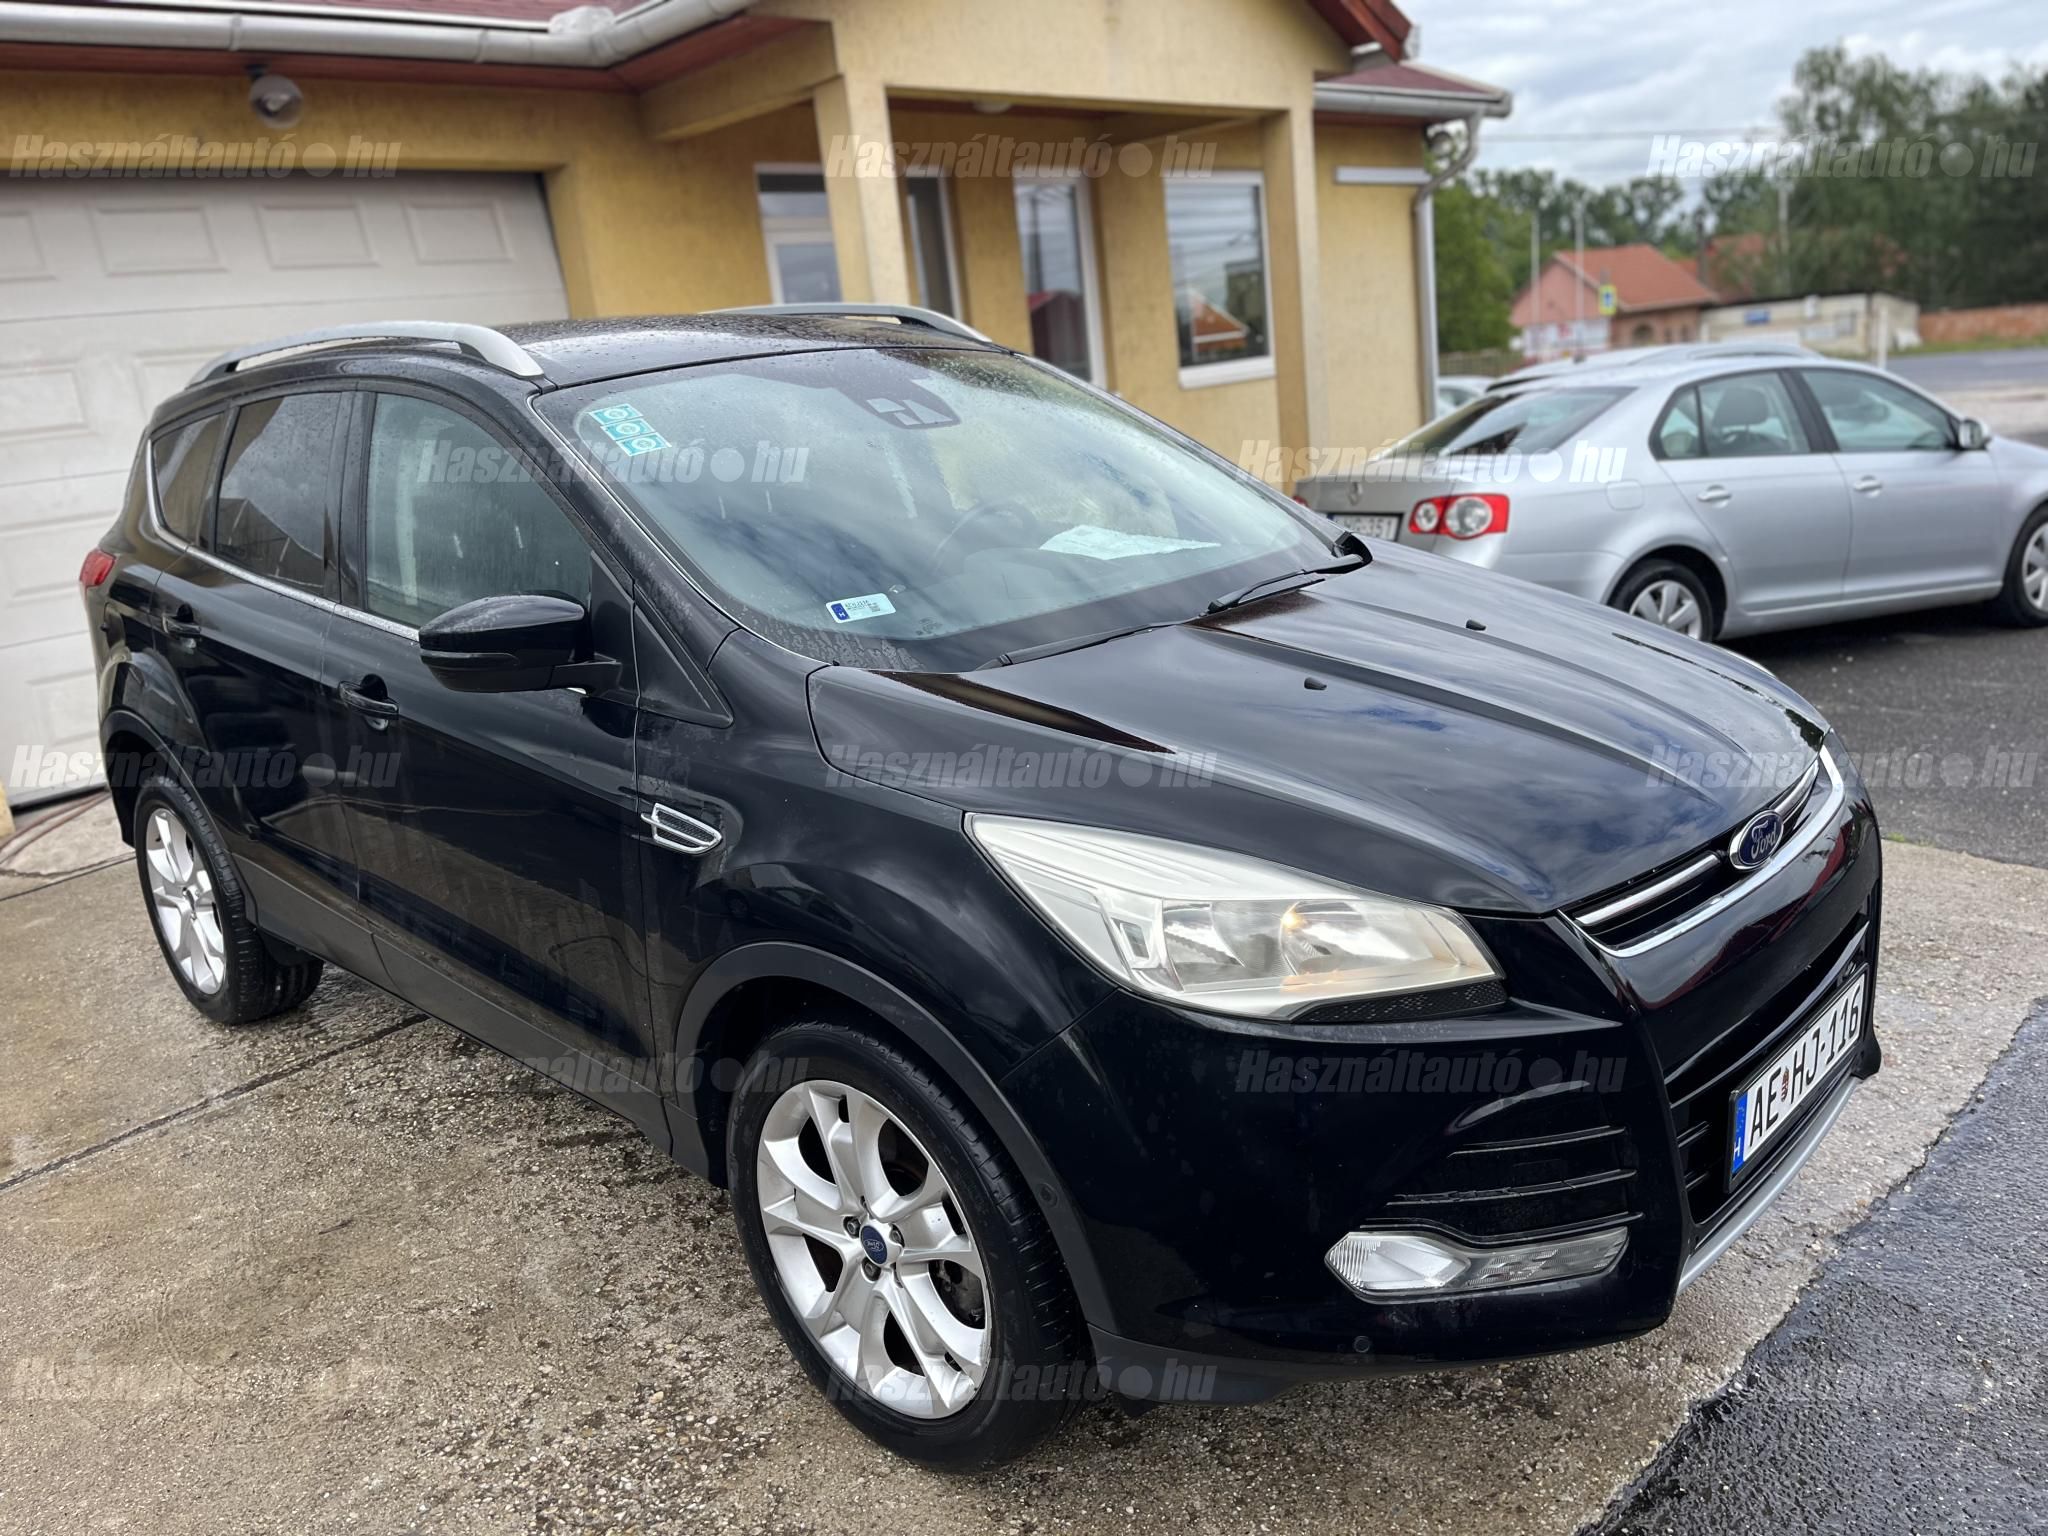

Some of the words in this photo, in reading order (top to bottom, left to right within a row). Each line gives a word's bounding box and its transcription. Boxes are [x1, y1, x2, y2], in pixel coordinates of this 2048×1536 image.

[1751, 820, 1777, 860] Ford
[1749, 1066, 1782, 1147] AE
[1790, 986, 1861, 1105] HJ-116
[1733, 1137, 1741, 1158] H
